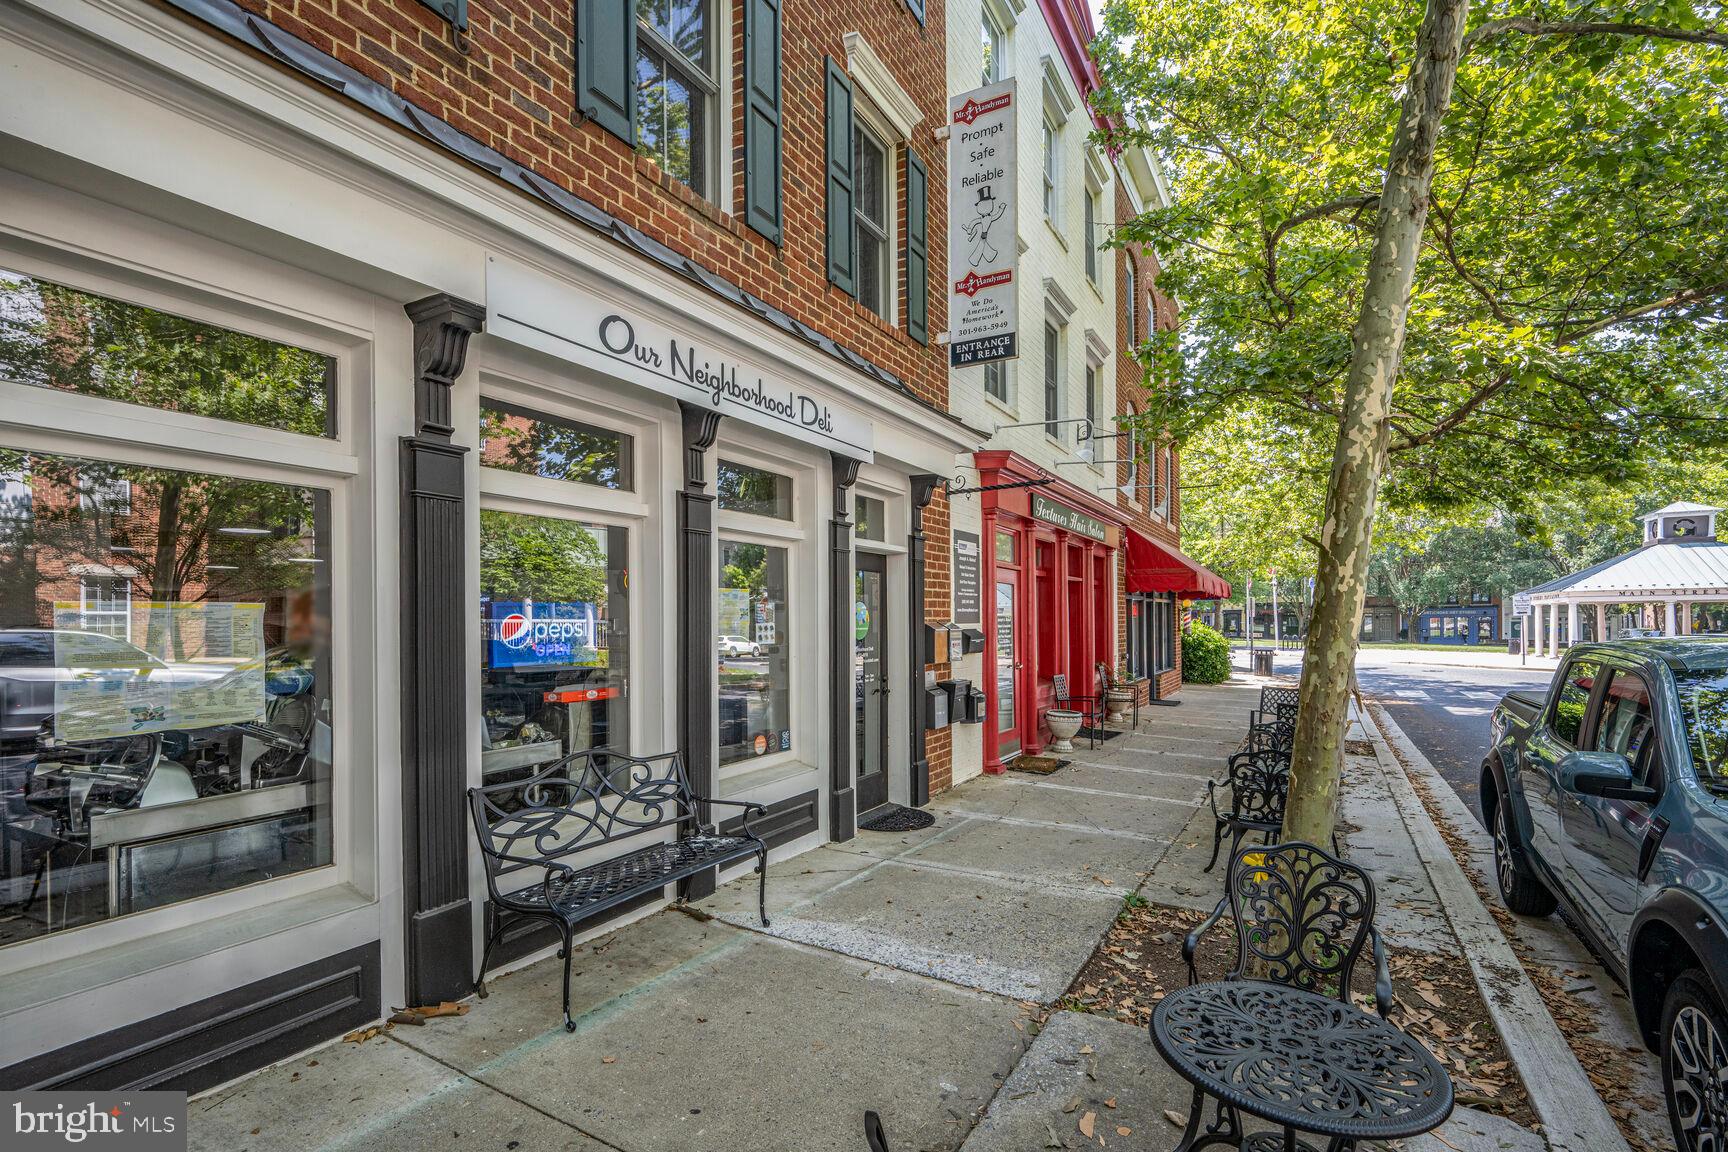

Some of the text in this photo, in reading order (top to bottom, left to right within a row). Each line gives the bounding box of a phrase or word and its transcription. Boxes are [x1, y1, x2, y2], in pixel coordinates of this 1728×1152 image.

[974, 97, 1009, 112] Handyman
[961, 122, 1004, 143] Prompt
[970, 147, 995, 162] Safe
[962, 167, 1004, 188] Reliable
[975, 273, 1010, 287] Handyman
[966, 304, 999, 316] America's
[956, 336, 1010, 353] ENTRANCE
[960, 347, 1005, 362] IN REAR
[598, 314, 833, 434] Our Neighborhood Deli
[1035, 497, 1104, 540] Textures Hair Salon
[534, 620, 588, 642] pepsi
[535, 642, 571, 657] OPEN
